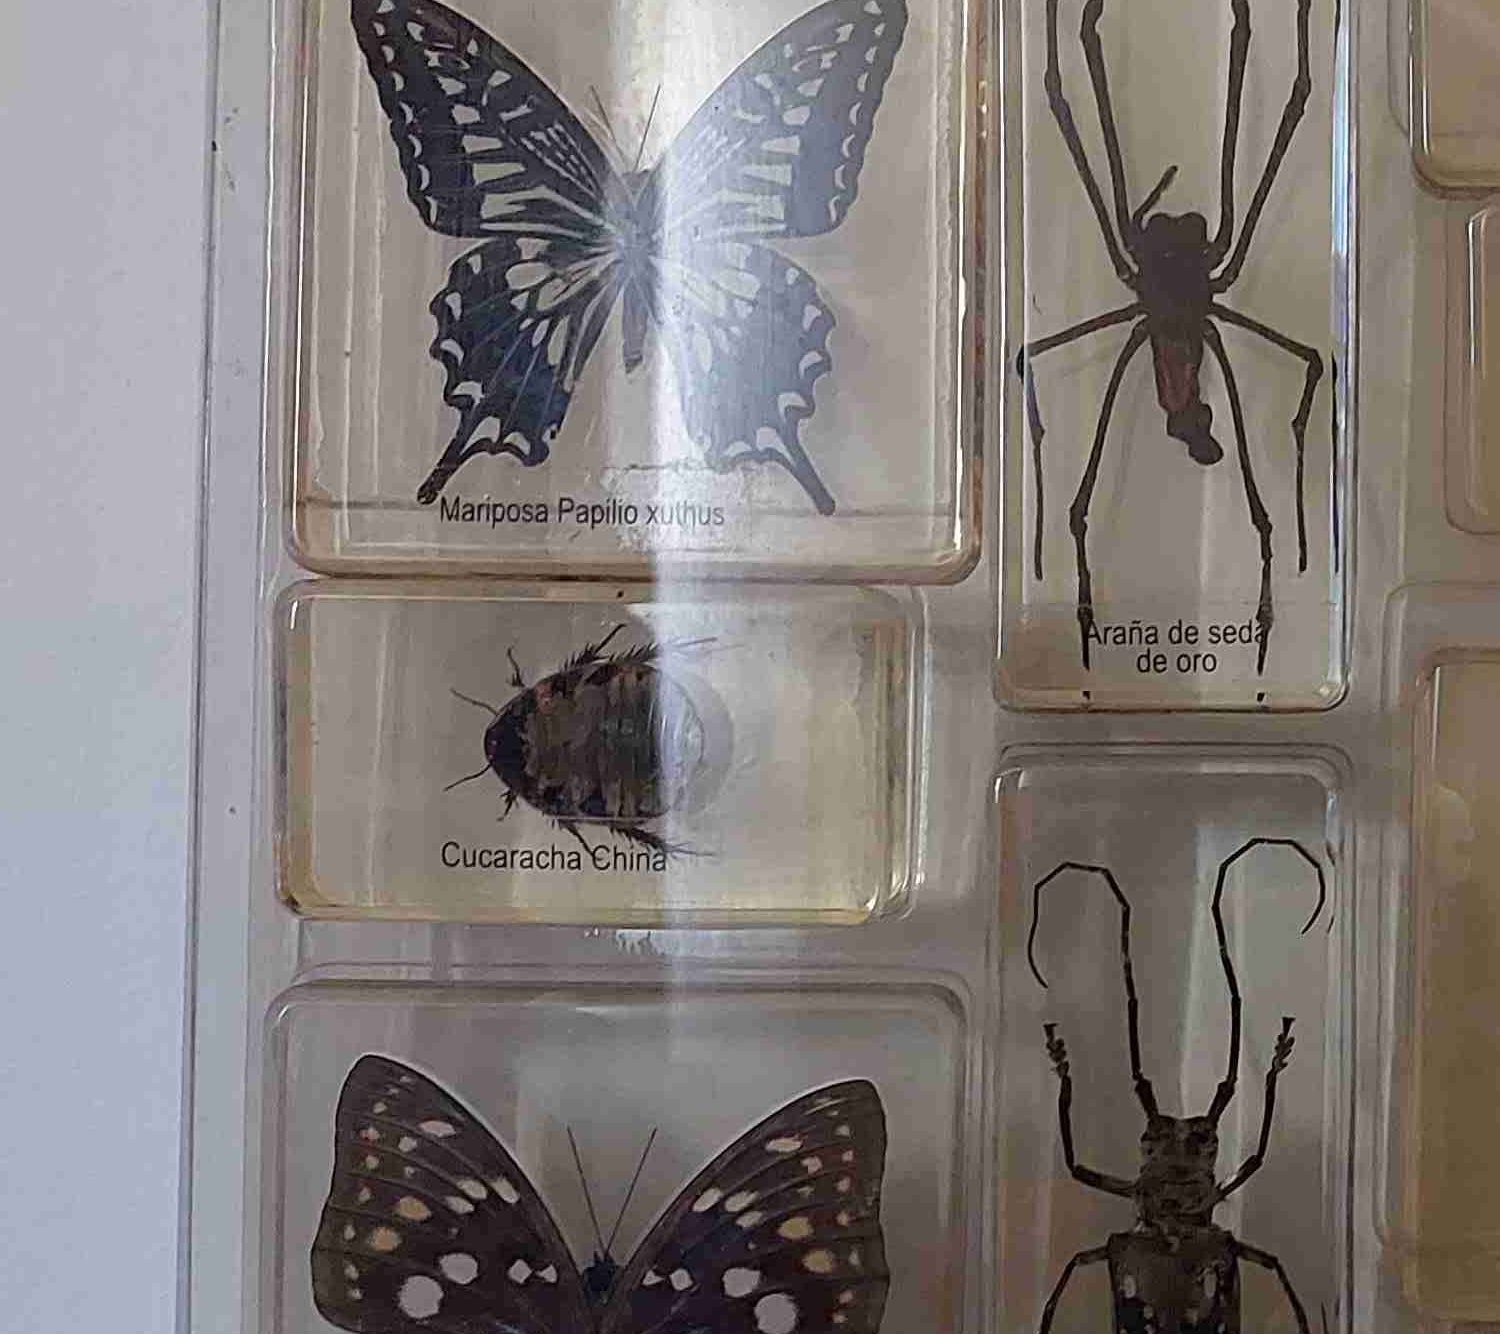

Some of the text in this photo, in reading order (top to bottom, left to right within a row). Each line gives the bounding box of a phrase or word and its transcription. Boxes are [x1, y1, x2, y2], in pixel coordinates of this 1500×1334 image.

[441, 495, 725, 530] Mariposa Papilio xuthus
[1087, 618, 1267, 645] Araña de seda
[1136, 648, 1217, 673] de oro
[441, 841, 666, 872] Cucaracha China
